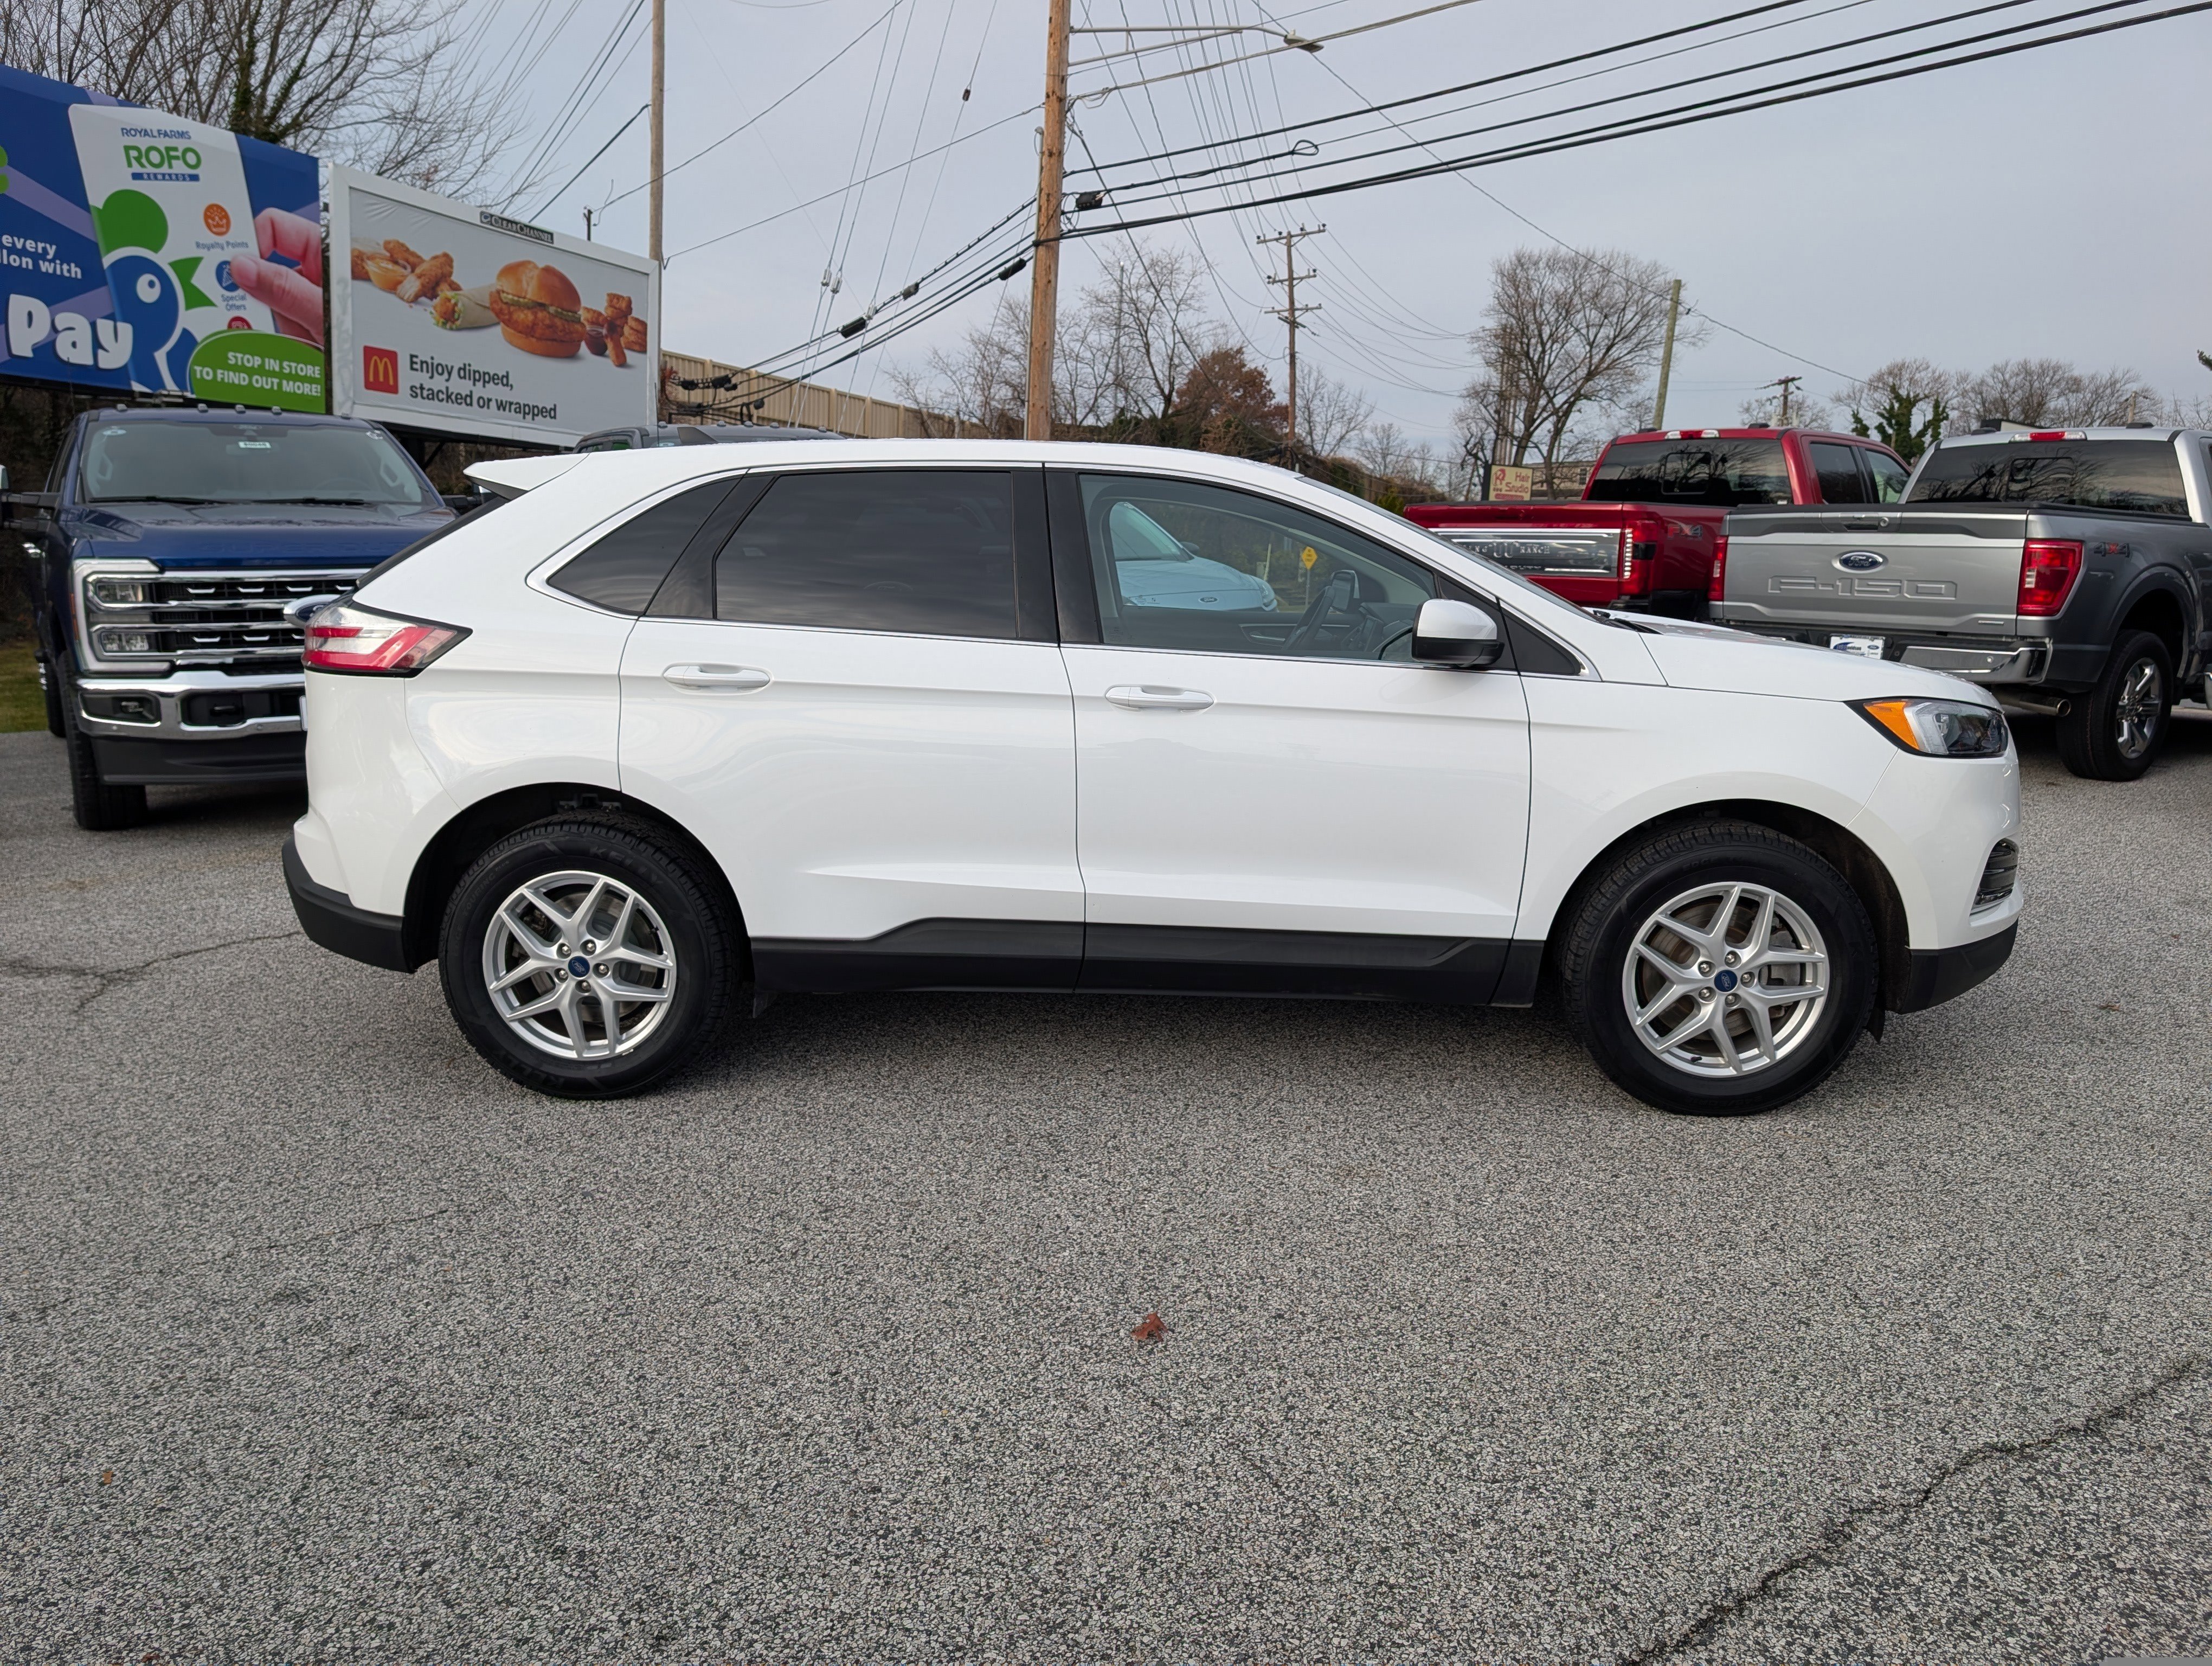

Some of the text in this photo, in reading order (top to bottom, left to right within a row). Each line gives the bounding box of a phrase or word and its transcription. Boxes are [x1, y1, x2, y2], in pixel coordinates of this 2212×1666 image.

[121, 127, 191, 140] ROYAL FARMS
[123, 145, 202, 170] ROFO
[2, 234, 56, 259] every
[196, 240, 249, 251] Royalty Points
[0, 248, 82, 279] lon with
[221, 293, 247, 303] Special
[225, 303, 247, 311] Offers
[8, 293, 133, 369] Pay
[228, 351, 321, 379] STOP IN STORE
[409, 353, 514, 390] Enjoy dipped,
[193, 366, 321, 397] TO FIND OUT MORE!
[410, 382, 557, 421] stacked or wrapped
[1848, 555, 1872, 567] Ford
[1768, 575, 1958, 600] F-150
